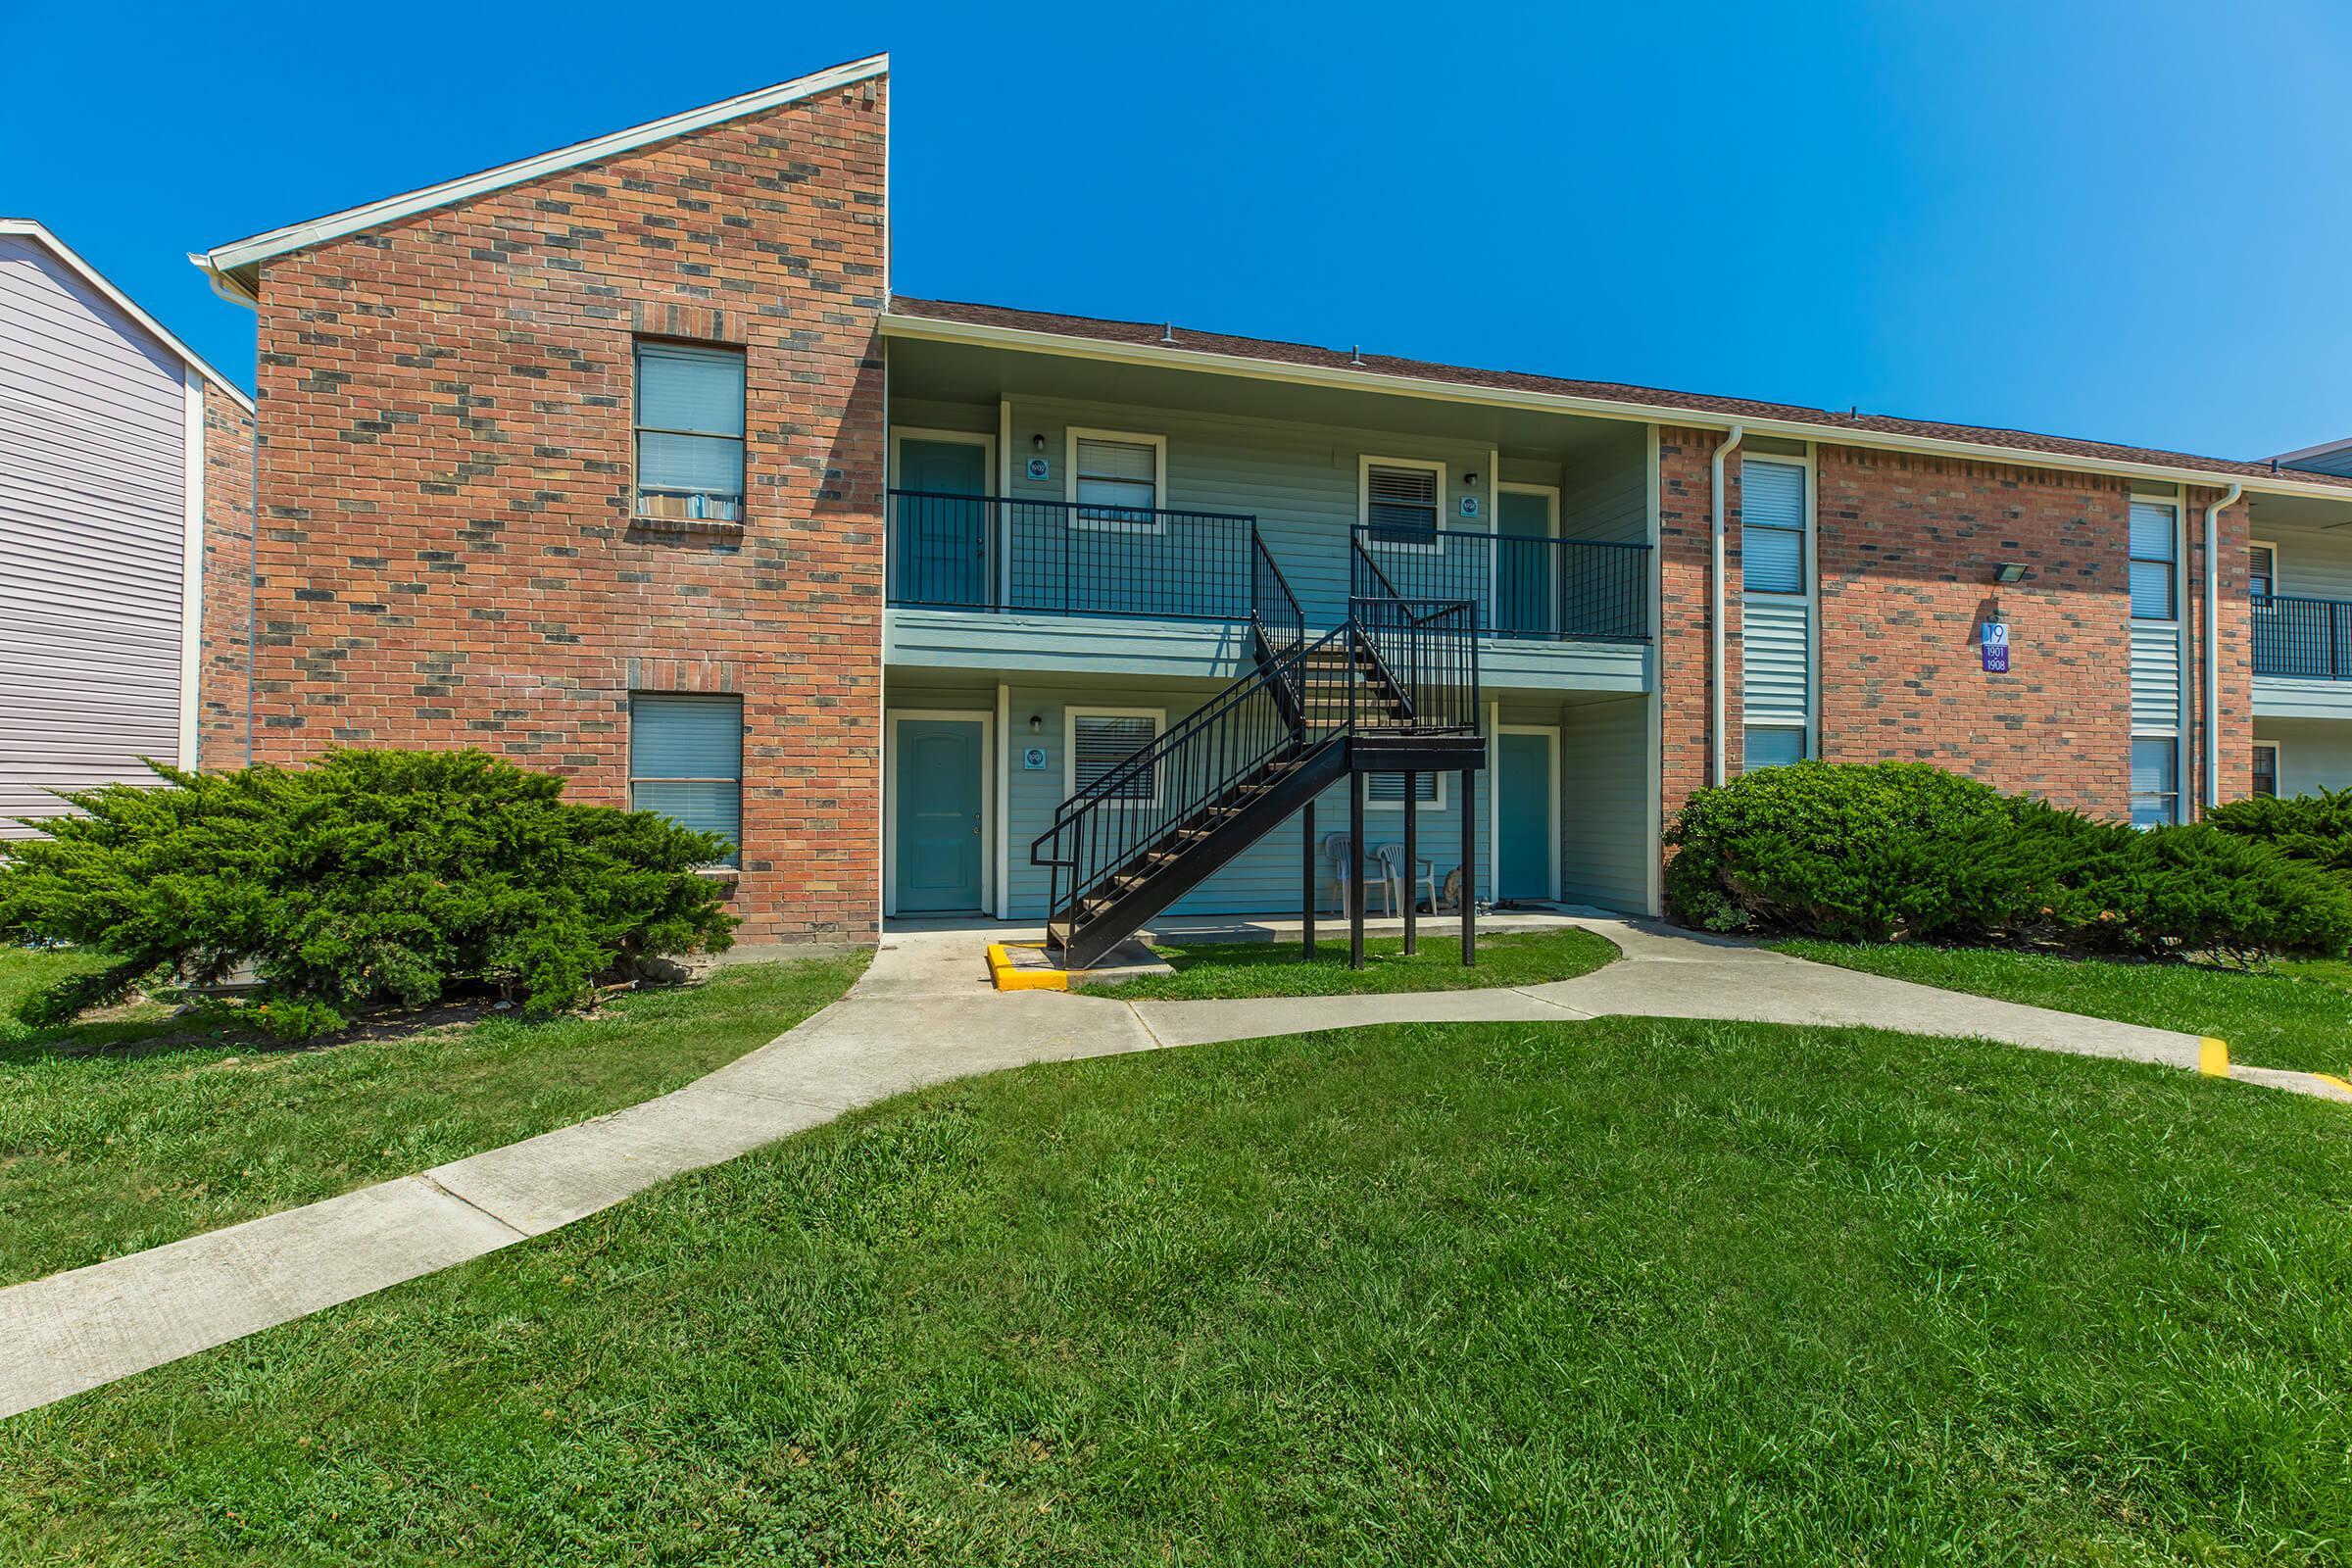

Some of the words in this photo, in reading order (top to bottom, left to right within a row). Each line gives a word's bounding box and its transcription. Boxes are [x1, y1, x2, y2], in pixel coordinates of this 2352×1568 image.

[1987, 624, 2003, 643] 19
[1987, 647, 2004, 657] 1901
[1987, 660, 2005, 670] 1908
